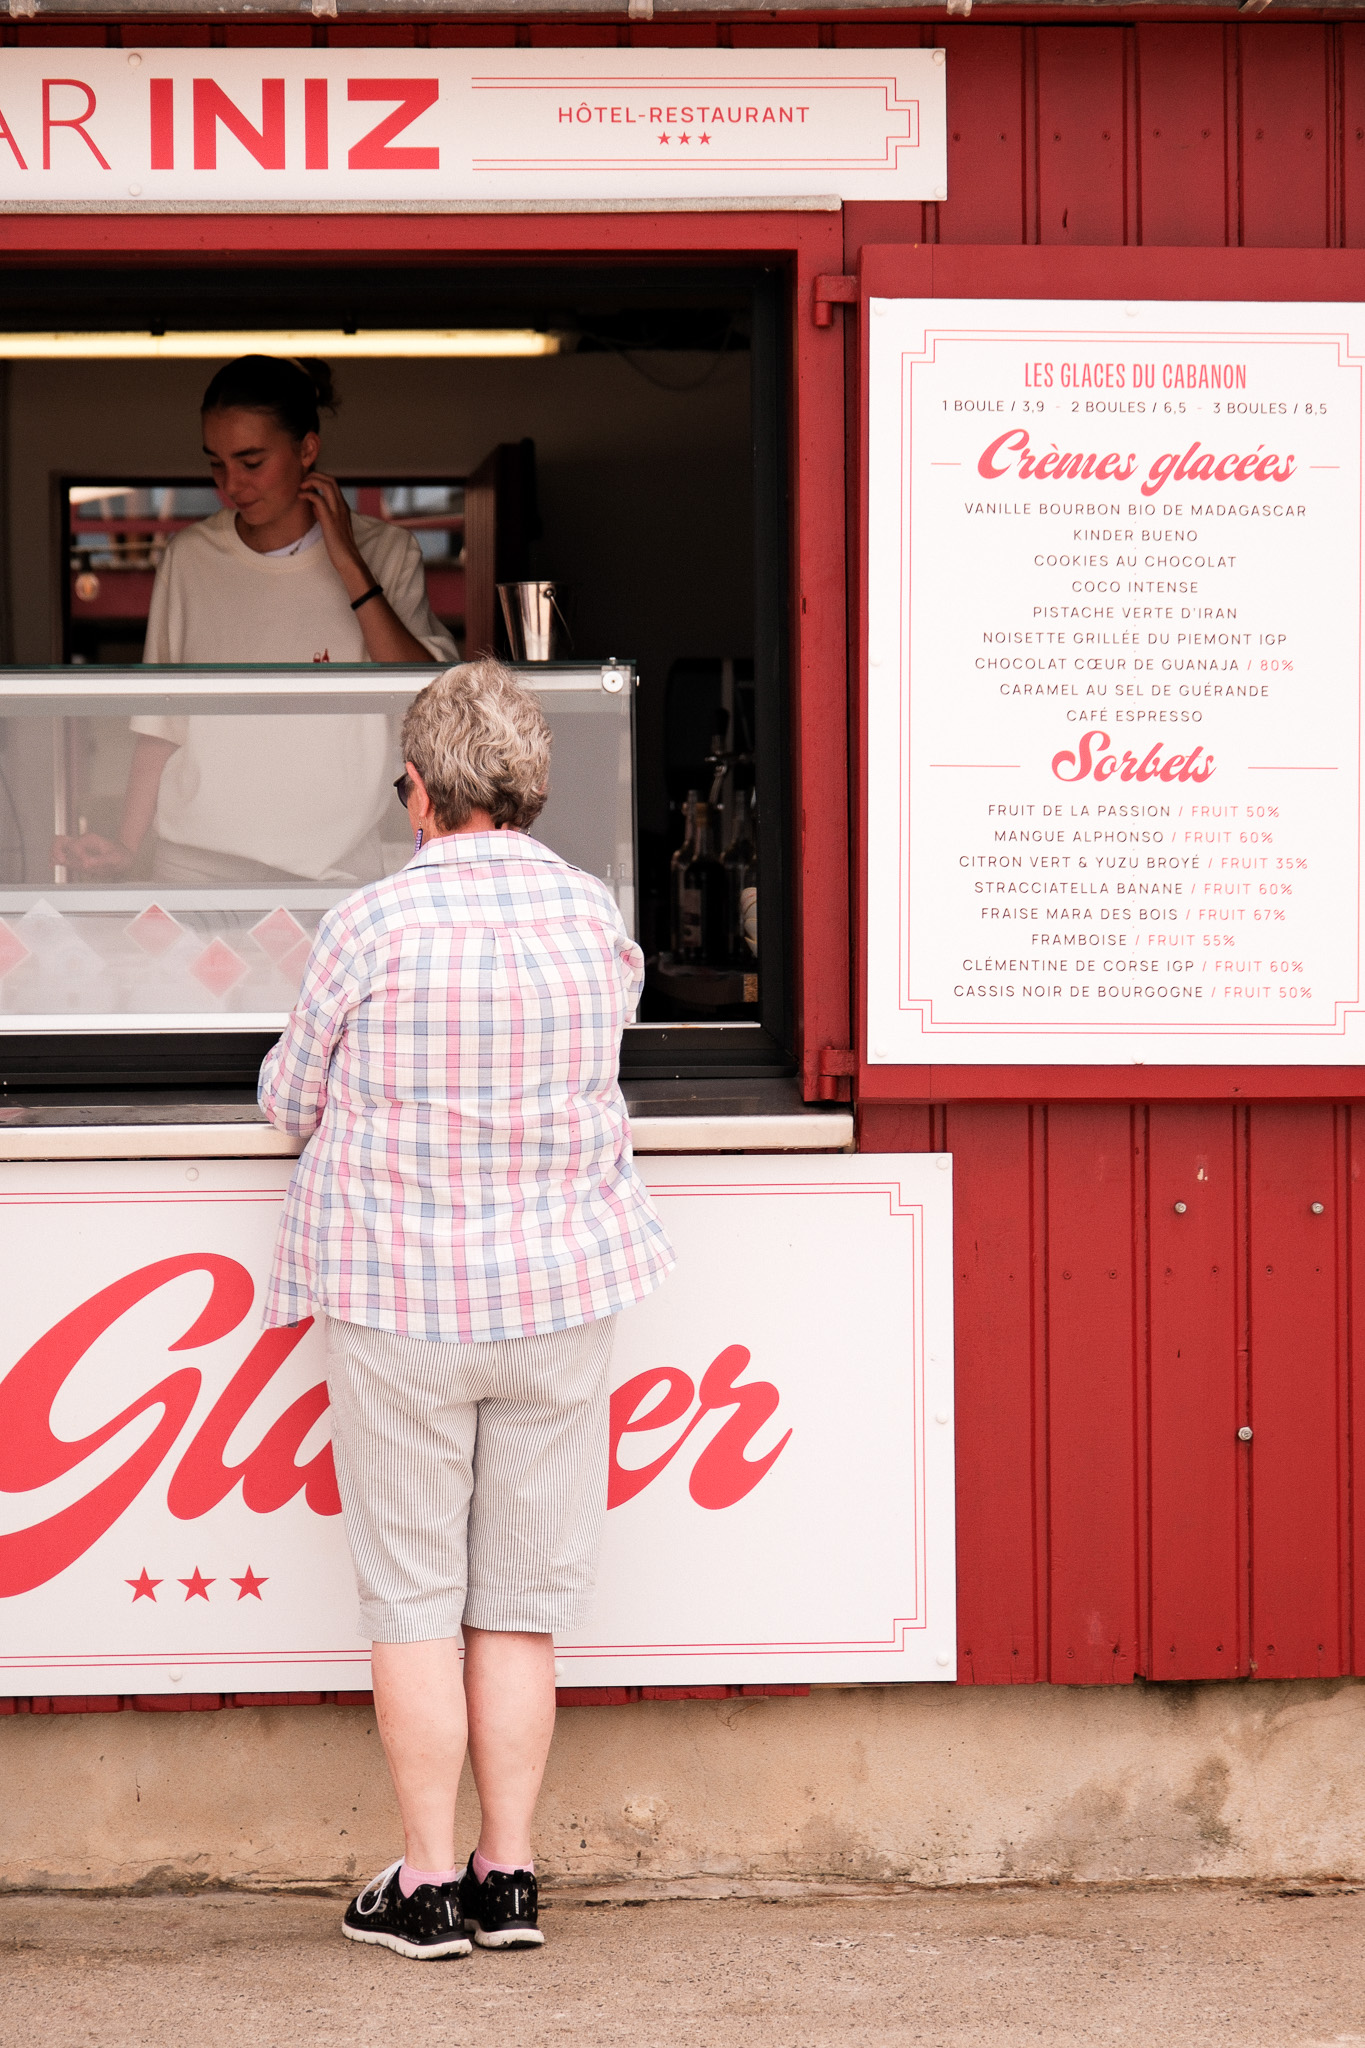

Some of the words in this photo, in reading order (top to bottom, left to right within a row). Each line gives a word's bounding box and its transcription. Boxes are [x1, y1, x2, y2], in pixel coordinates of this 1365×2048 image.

[558, 102, 810, 124] HÔTEL-RESTAURANT
[150, 78, 439, 170] INIZ
[1025, 362, 1053, 388] LES
[1061, 362, 1125, 389] GLACES
[1133, 363, 1155, 389] DU
[1163, 363, 1246, 389] CABANON
[942, 400, 947, 411] 1
[954, 400, 1004, 412] BOULE
[1023, 401, 1044, 413] 3,9
[1072, 401, 1079, 412] 2
[1086, 401, 1146, 413] BOULES
[1164, 402, 1186, 415] 6,5
[1213, 402, 1220, 414] 3
[1227, 402, 1287, 414] BOULES
[1305, 403, 1327, 416] 8,5
[978, 429, 1137, 481] Crèmes
[1141, 442, 1297, 496] glacées
[965, 503, 1031, 514] VANILLE
[1040, 503, 1120, 515] BOURBON
[1128, 504, 1155, 516] BIO
[1164, 504, 1182, 516] DE
[1191, 504, 1306, 517] MADAGASCAR
[1074, 529, 1133, 541] KINDER
[1142, 530, 1197, 542] BUENO
[1034, 555, 1108, 567] COOKIES
[1116, 555, 1136, 567] AU
[1145, 556, 1236, 567] CHOCOLAT
[1072, 581, 1120, 592] COCO
[1129, 581, 1198, 593] INTENSE
[1033, 606, 1114, 618] PISTACHE
[1122, 607, 1173, 619] VERTE
[1181, 608, 1236, 619] D'IRAN
[984, 632, 1065, 644] NOISETTE
[1073, 629, 1139, 644] GRILLÉE
[1148, 633, 1169, 644] DU
[1178, 633, 1252, 645] PIEMONT
[1260, 634, 1286, 645] IGP
[975, 658, 1067, 669] CHOCOLAT
[1074, 658, 1126, 670] CŒUR
[1134, 659, 1154, 670] DE
[1162, 659, 1238, 671] GUANAJA
[1260, 660, 1293, 671] 80%
[1000, 683, 1078, 695] CARAMEL
[1086, 684, 1107, 696] AU
[1115, 684, 1144, 696] SEL
[1152, 685, 1171, 696] DE
[1179, 682, 1269, 697] GUÉRANDE
[1067, 707, 1107, 722] CAFÉ
[1116, 710, 1202, 722] ESPRESSO
[1052, 731, 1216, 783] Sorbets
[989, 804, 1035, 816] FRUIT
[1043, 805, 1062, 816] DE
[1071, 805, 1090, 816] LA
[1098, 805, 1170, 817] PASSION
[1192, 806, 1238, 817] FRUIT
[1247, 806, 1279, 818] 50%
[995, 830, 1064, 842] MANGUE
[1073, 831, 1163, 843] ALPHONSO
[1185, 832, 1232, 843] FRUIT
[1240, 832, 1273, 843] 60%
[959, 856, 1021, 867] CITRON
[1030, 856, 1071, 868] VERT
[1079, 857, 1088, 868] &
[1096, 857, 1138, 868] YUZU
[1147, 854, 1199, 869] BROYÉ
[1222, 857, 1268, 869] FRUIT
[1276, 858, 1307, 869] 35%
[975, 882, 1109, 894] STRACCIATELLA
[1117, 883, 1182, 894] BANANE
[1204, 883, 1251, 895] FRUIT
[1259, 883, 1292, 895] 60%
[982, 908, 1038, 919] FRAISE
[1047, 908, 1092, 919] MARA
[1101, 909, 1131, 920] DES
[1139, 909, 1177, 920] BOIS
[1199, 909, 1245, 920] FRUIT
[1254, 909, 1285, 920] 67%
[1032, 934, 1126, 946] FRAMBOISE
[1148, 935, 1195, 946] FRUIT
[1203, 935, 1235, 946] 55%
[963, 956, 1067, 971] CLÉMENTINE
[1076, 960, 1095, 971] DE
[1103, 960, 1159, 972] CORSE
[1167, 960, 1194, 972] IGP
[1216, 961, 1262, 972] FRUIT
[1270, 961, 1303, 973] 60%
[954, 985, 1014, 997] CASSIS
[1023, 986, 1062, 997] NOIR
[1070, 986, 1089, 997] DE
[1098, 986, 1203, 998] BOURGOGNE
[1225, 987, 1271, 998] FRUIT
[1280, 987, 1312, 998] 50%
[0, 1253, 792, 1598] Glaer
